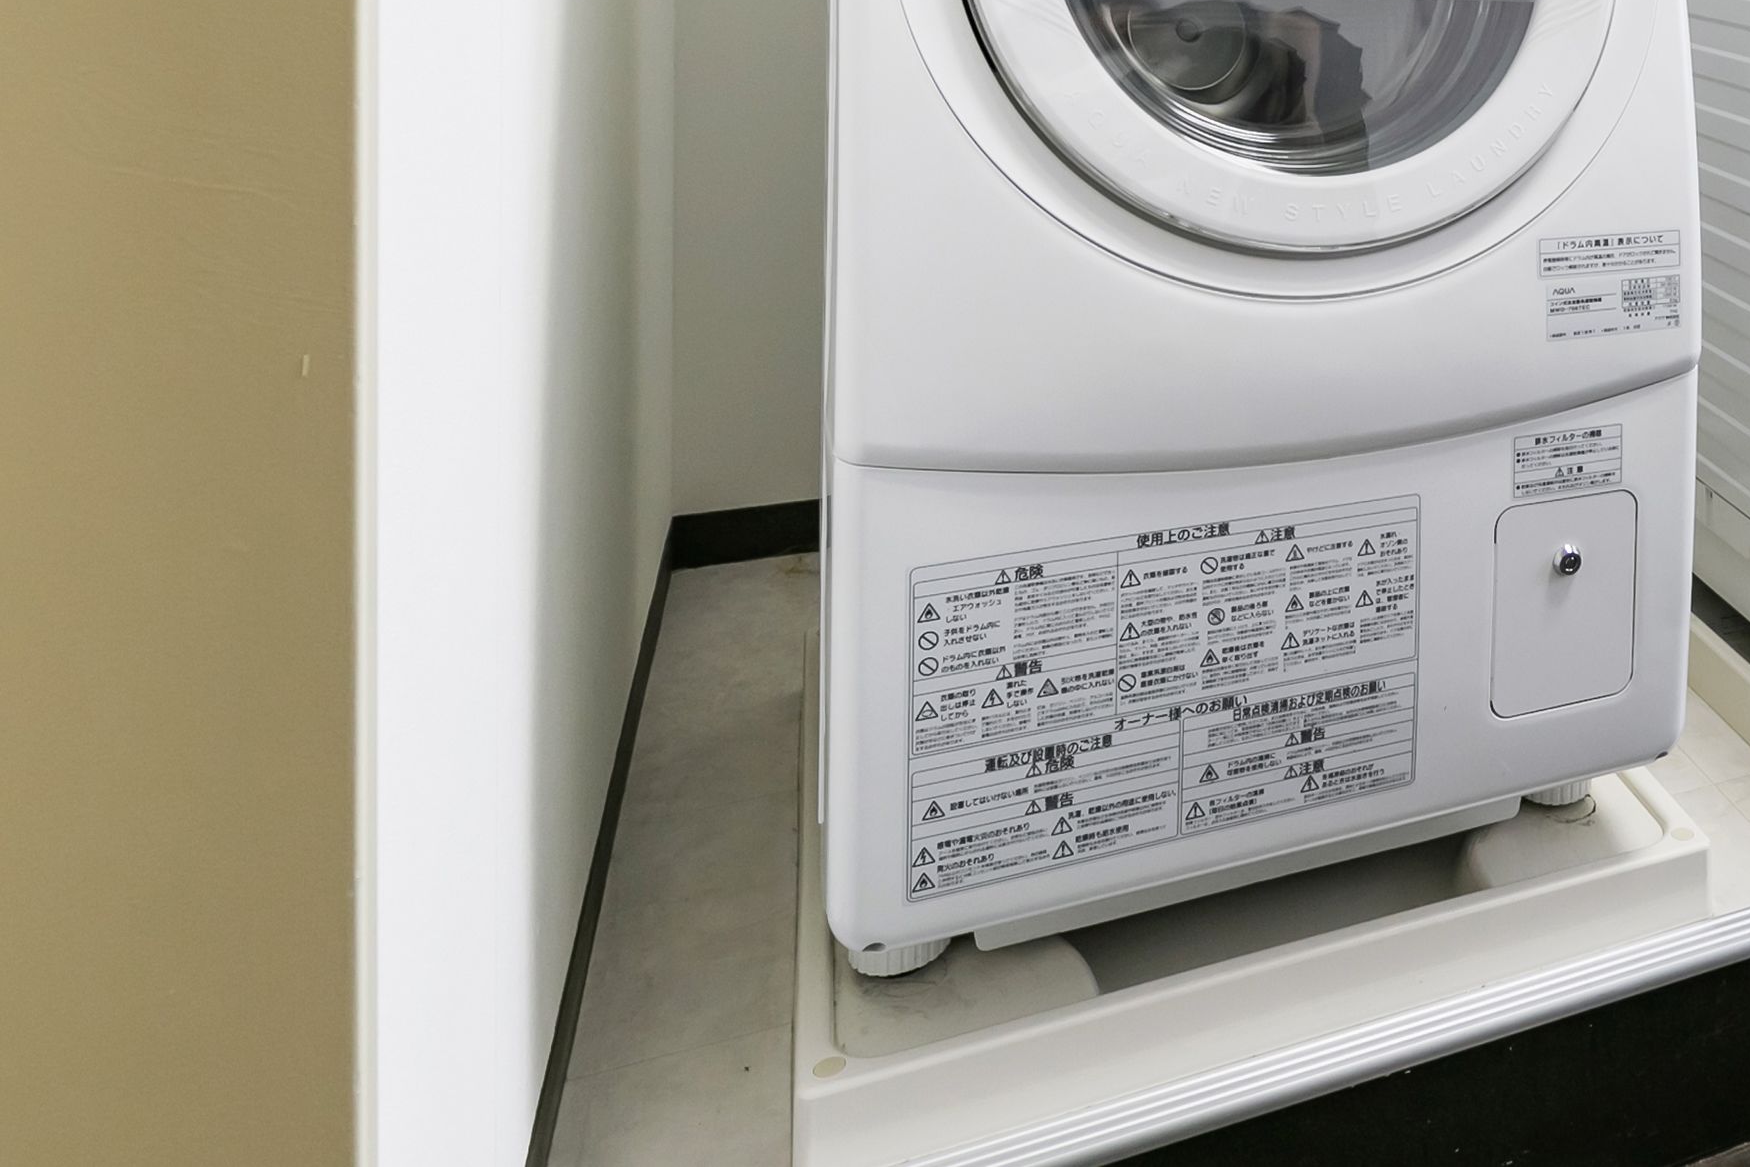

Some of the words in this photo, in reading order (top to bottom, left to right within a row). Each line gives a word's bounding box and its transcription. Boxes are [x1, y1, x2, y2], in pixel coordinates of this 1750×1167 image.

[1283, 193, 1403, 222] STYLE
[1424, 81, 1556, 199] LAUNDRY
[1552, 287, 1575, 295] AQUA
[1137, 522, 1230, 548] 使用上のご注意
[1271, 526, 1296, 542] 注意
[1015, 564, 1044, 582] 危険
[946, 613, 967, 624] しない
[1006, 699, 1028, 709] しない
[1115, 695, 1248, 731] オーナー様へのお願い
[984, 734, 1113, 774] 運転及び設置時のご注意
[1045, 755, 1075, 775] 危険
